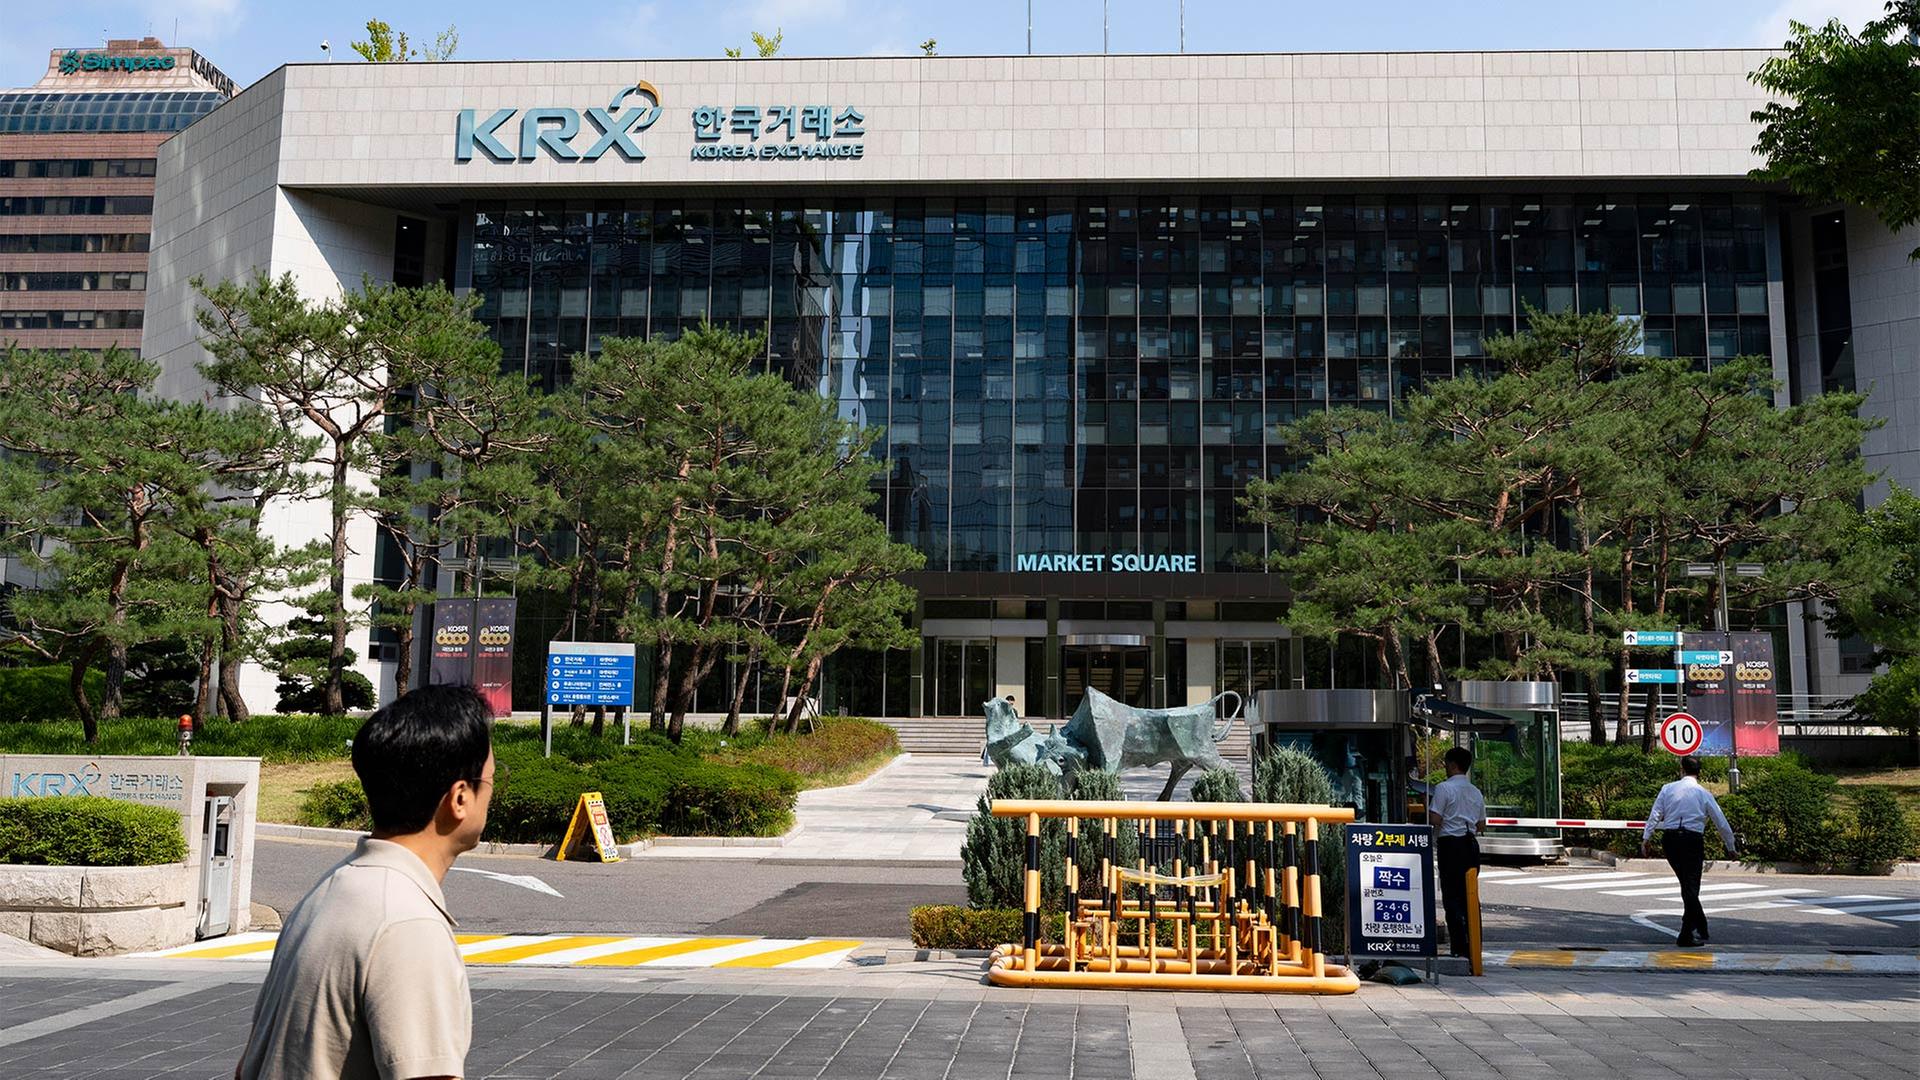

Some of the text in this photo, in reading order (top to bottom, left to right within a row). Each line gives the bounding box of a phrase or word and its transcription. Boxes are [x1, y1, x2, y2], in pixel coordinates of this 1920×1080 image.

[82, 53, 176, 73] Simpac
[190, 49, 234, 98] KANTAR
[692, 105, 866, 141] 한국거래소
[455, 105, 648, 164] KRX
[691, 144, 865, 161] KOREA EXCHANGE
[1017, 554, 1196, 573] MARKET SQUARE
[1669, 725, 1694, 745] 10
[12, 773, 92, 798] KRX
[110, 773, 183, 791] 한국거래소
[1351, 831, 1429, 847] 차량 2부제 시행
[1362, 854, 1383, 863] 오늘은
[1378, 870, 1406, 887] 짝수
[1365, 923, 1380, 933] 차량
[1382, 923, 1413, 934] 운행하는
[1367, 942, 1393, 952] KRX
